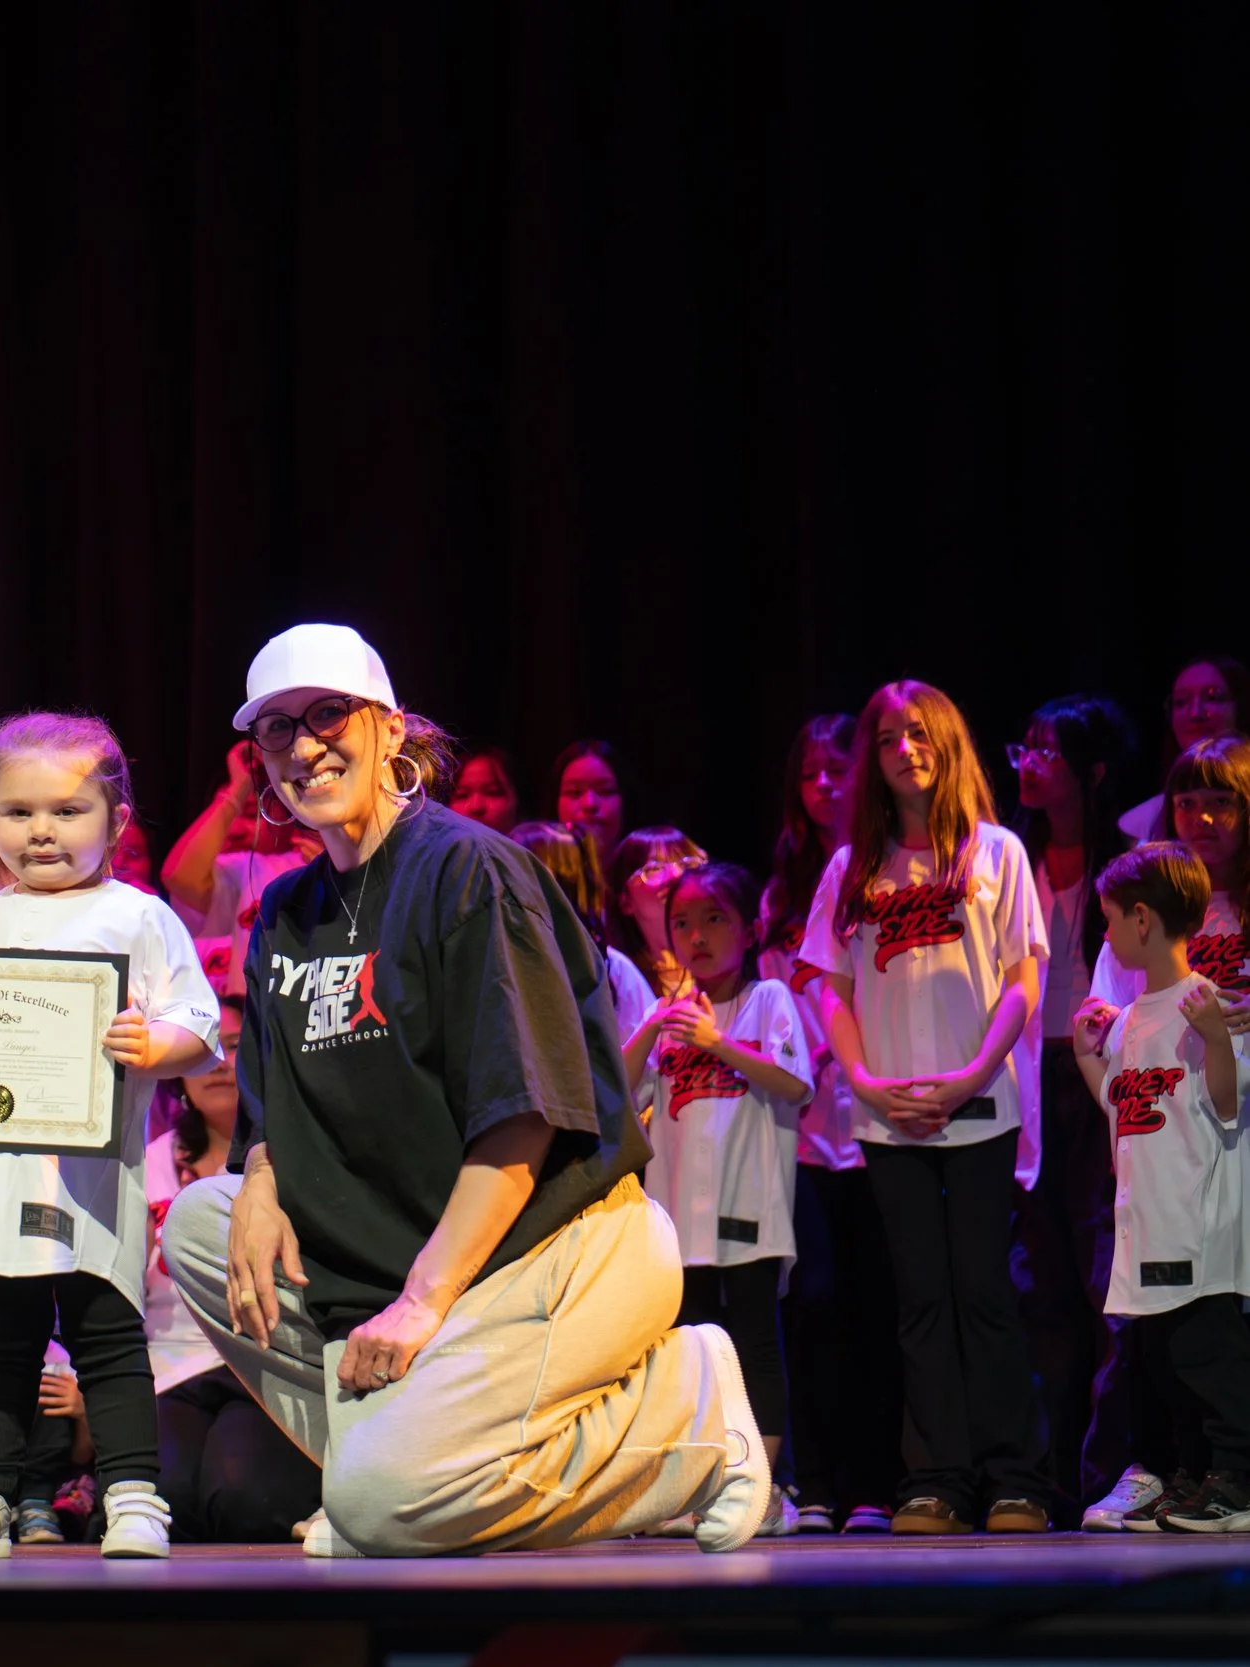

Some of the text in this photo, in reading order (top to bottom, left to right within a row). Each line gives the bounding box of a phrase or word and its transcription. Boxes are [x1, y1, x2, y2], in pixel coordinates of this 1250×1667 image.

[13, 991, 70, 1017] Excellence
[304, 990, 356, 1042] SIDE
[301, 1028, 389, 1053] DANCE SCHOOL
